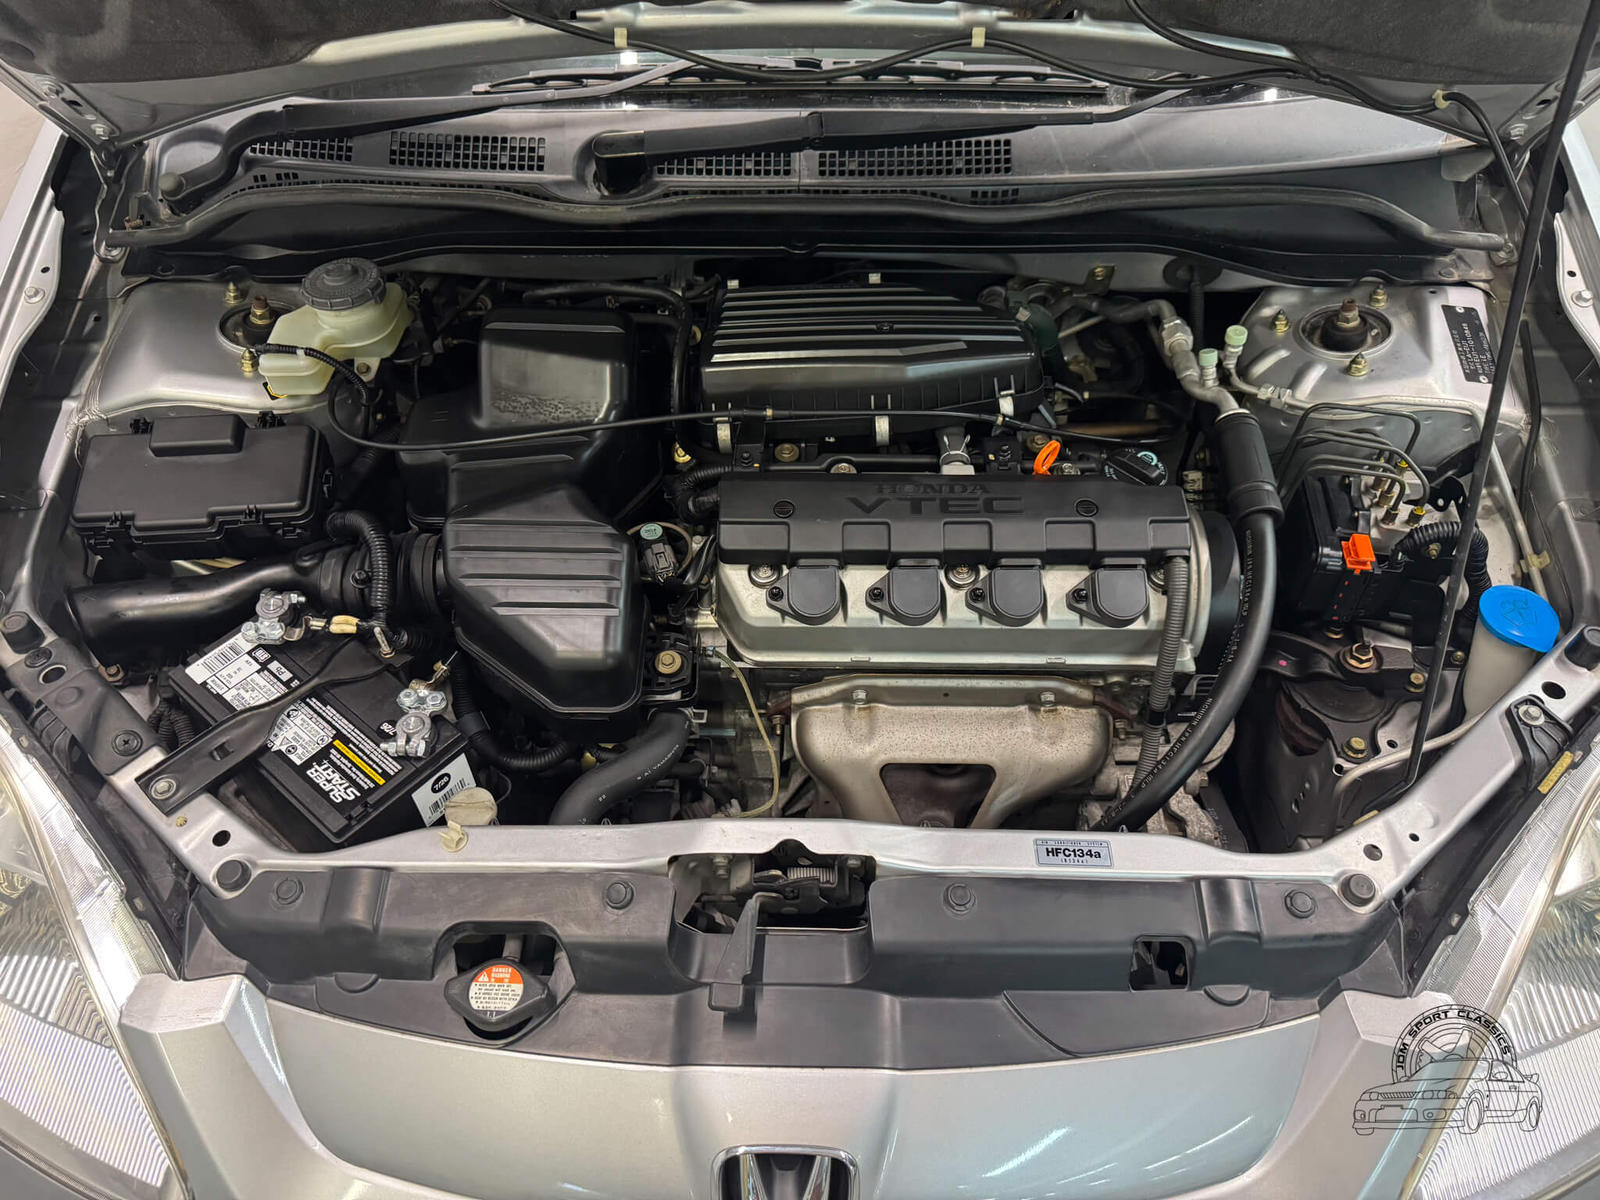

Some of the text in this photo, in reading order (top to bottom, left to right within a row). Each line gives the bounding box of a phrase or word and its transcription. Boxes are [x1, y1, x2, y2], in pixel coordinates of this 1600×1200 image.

[876, 483, 991, 494] HONDA
[846, 496, 1024, 515] VTEC
[275, 666, 286, 676] Pb
[1192, 698, 1213, 726] NICHIRIN
[380, 722, 397, 736] 7/26
[306, 767, 343, 803] SUPER
[314, 764, 361, 801] START
[433, 777, 449, 791] 7/26
[1046, 847, 1101, 859] HFC134a
